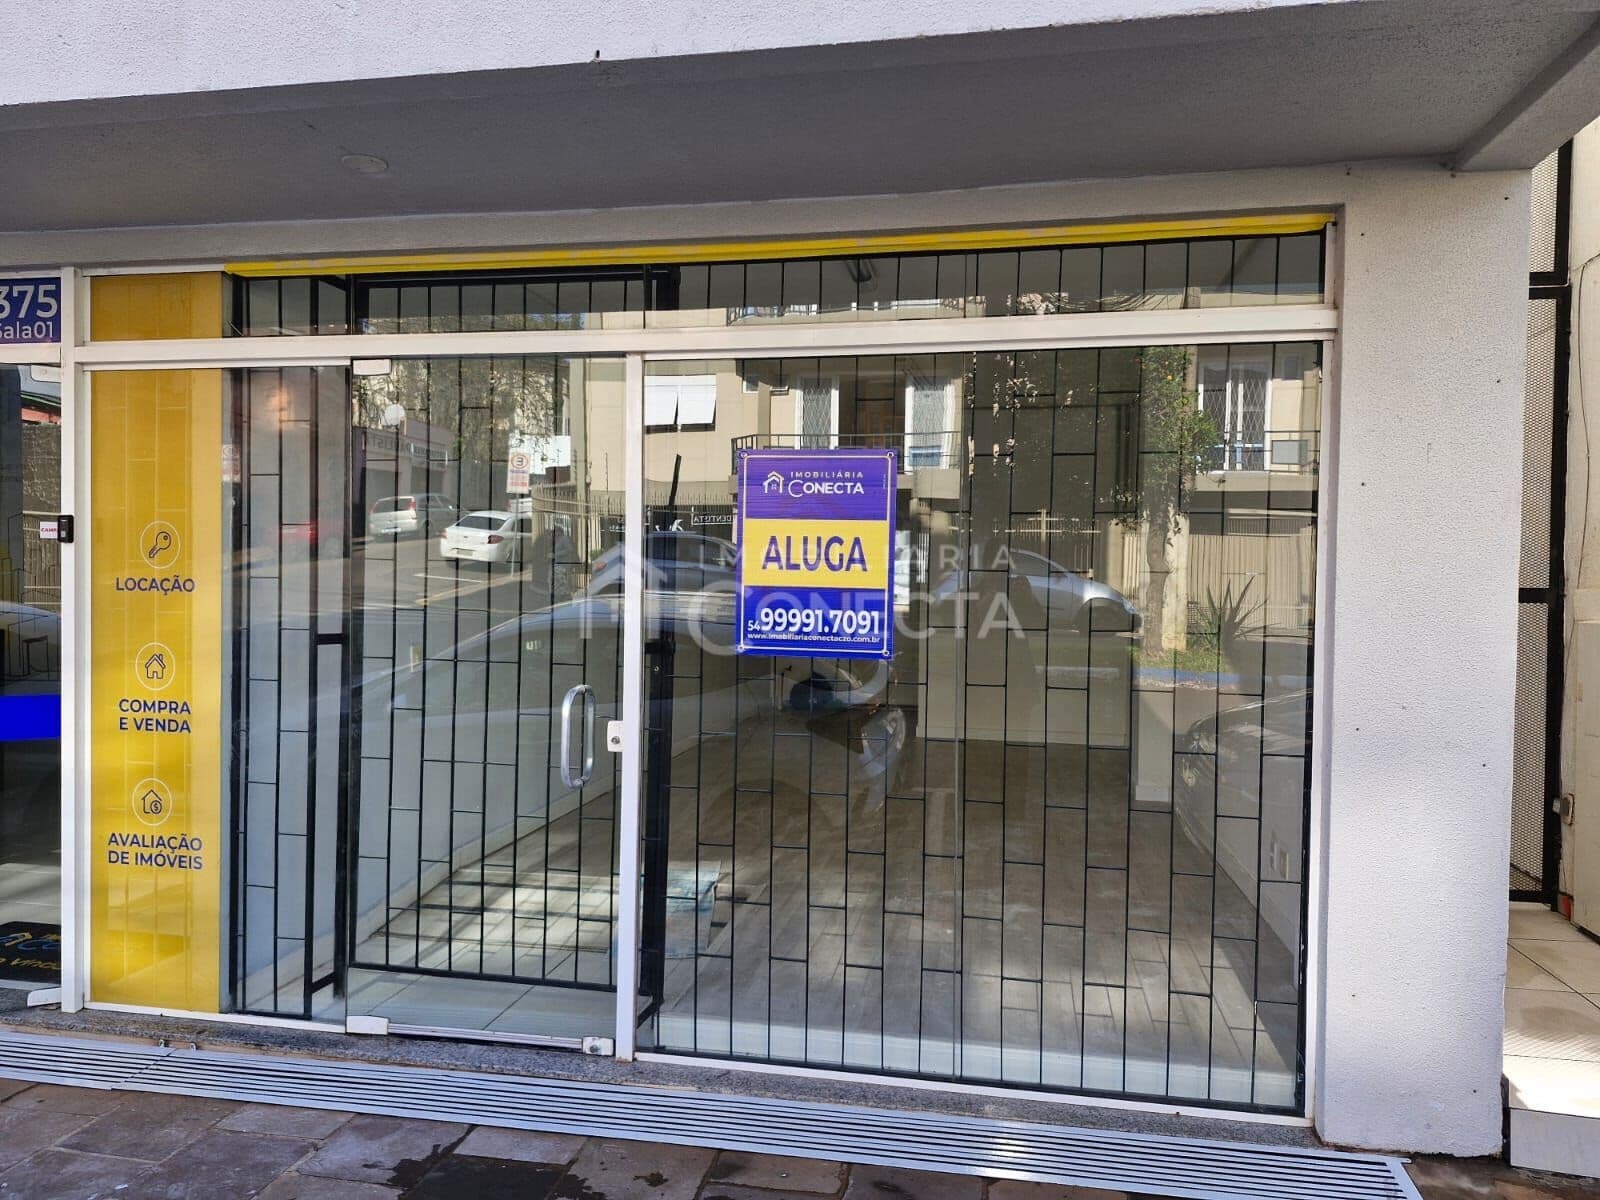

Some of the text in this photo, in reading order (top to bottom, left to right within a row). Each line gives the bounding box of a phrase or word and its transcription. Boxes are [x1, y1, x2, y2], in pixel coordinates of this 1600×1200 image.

[0, 320, 53, 339] ala01
[790, 470, 864, 479] IMOBILIÁRIA
[788, 479, 865, 498] CONECTA
[762, 535, 868, 572] ALUGA
[115, 575, 196, 595] LOCAÇÃO
[760, 607, 880, 634] 99991.7091
[119, 698, 191, 715] COMPRA
[119, 717, 192, 734] E VENDA
[108, 832, 203, 854] AVALIAÇÃO
[108, 850, 203, 870] DE IMÓVEIS
